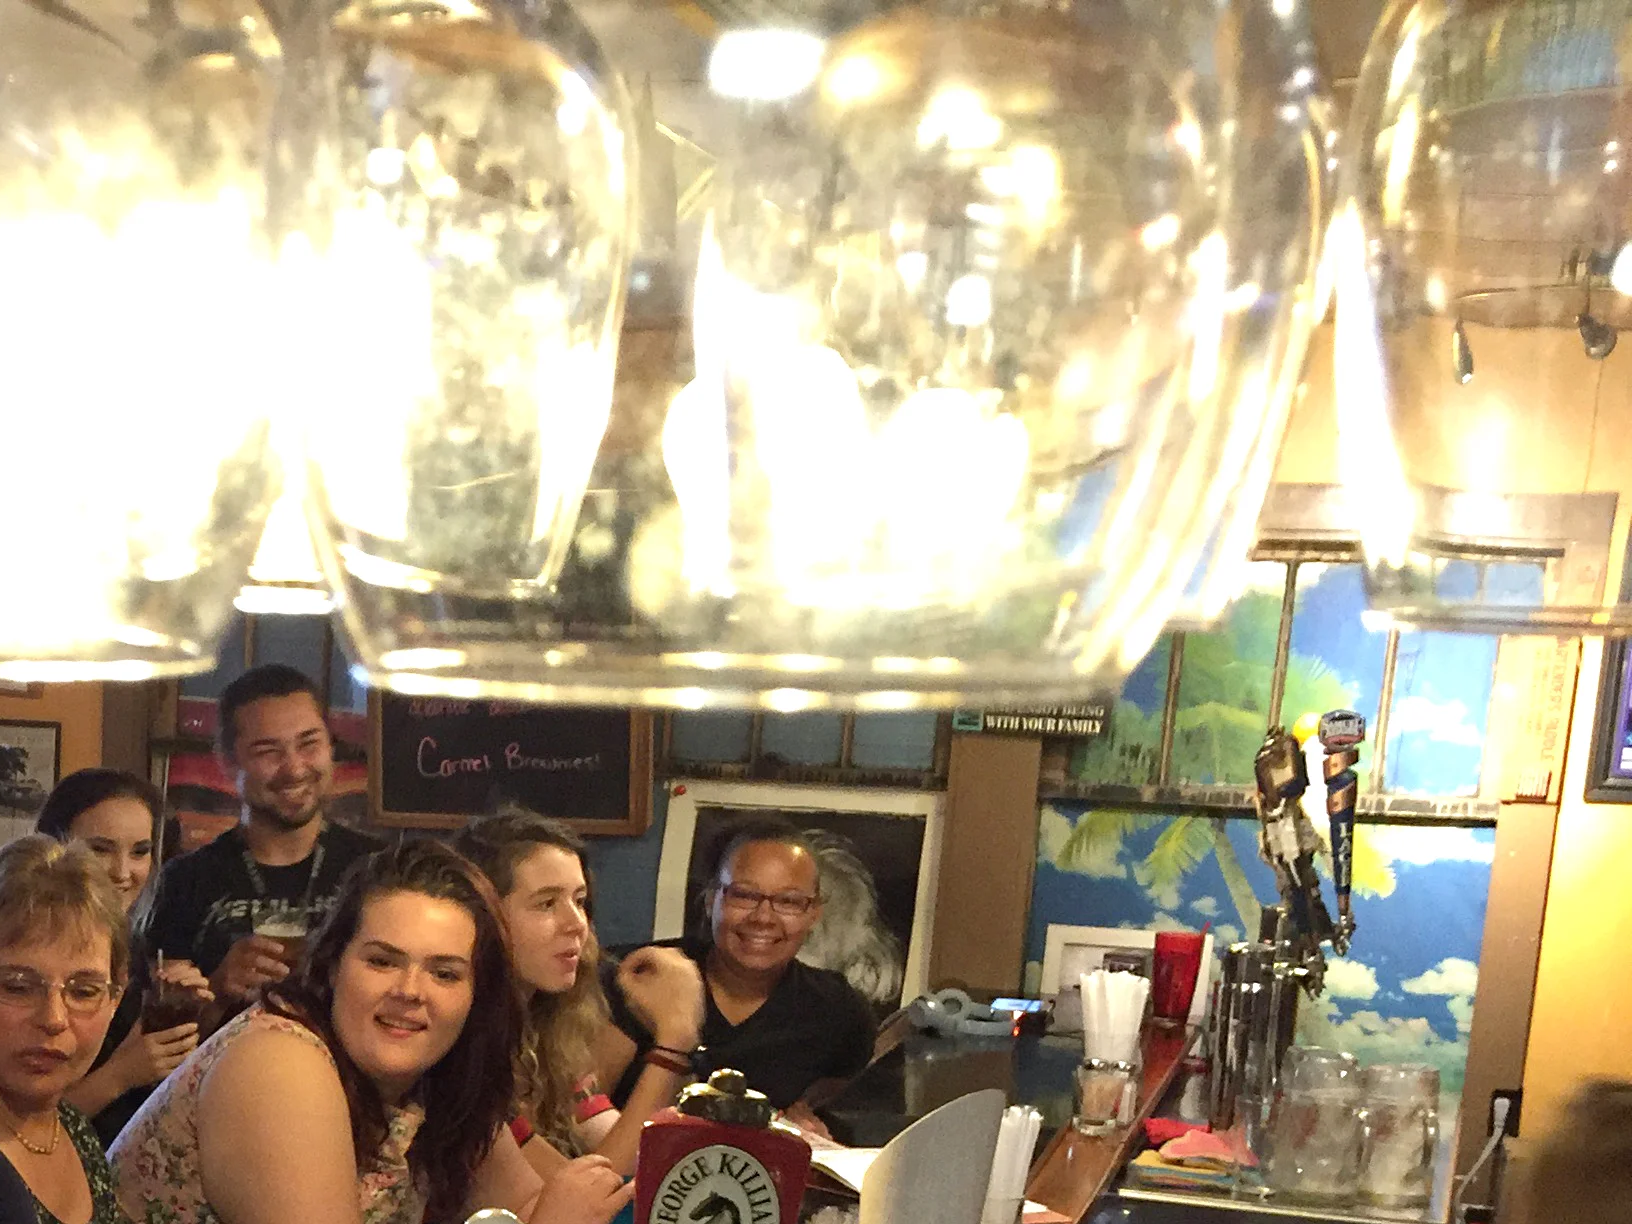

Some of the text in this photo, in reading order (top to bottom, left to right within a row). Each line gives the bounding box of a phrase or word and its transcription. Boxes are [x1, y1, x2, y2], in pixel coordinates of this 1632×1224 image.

[985, 714, 1104, 735] WITH YOUR FAMILY
